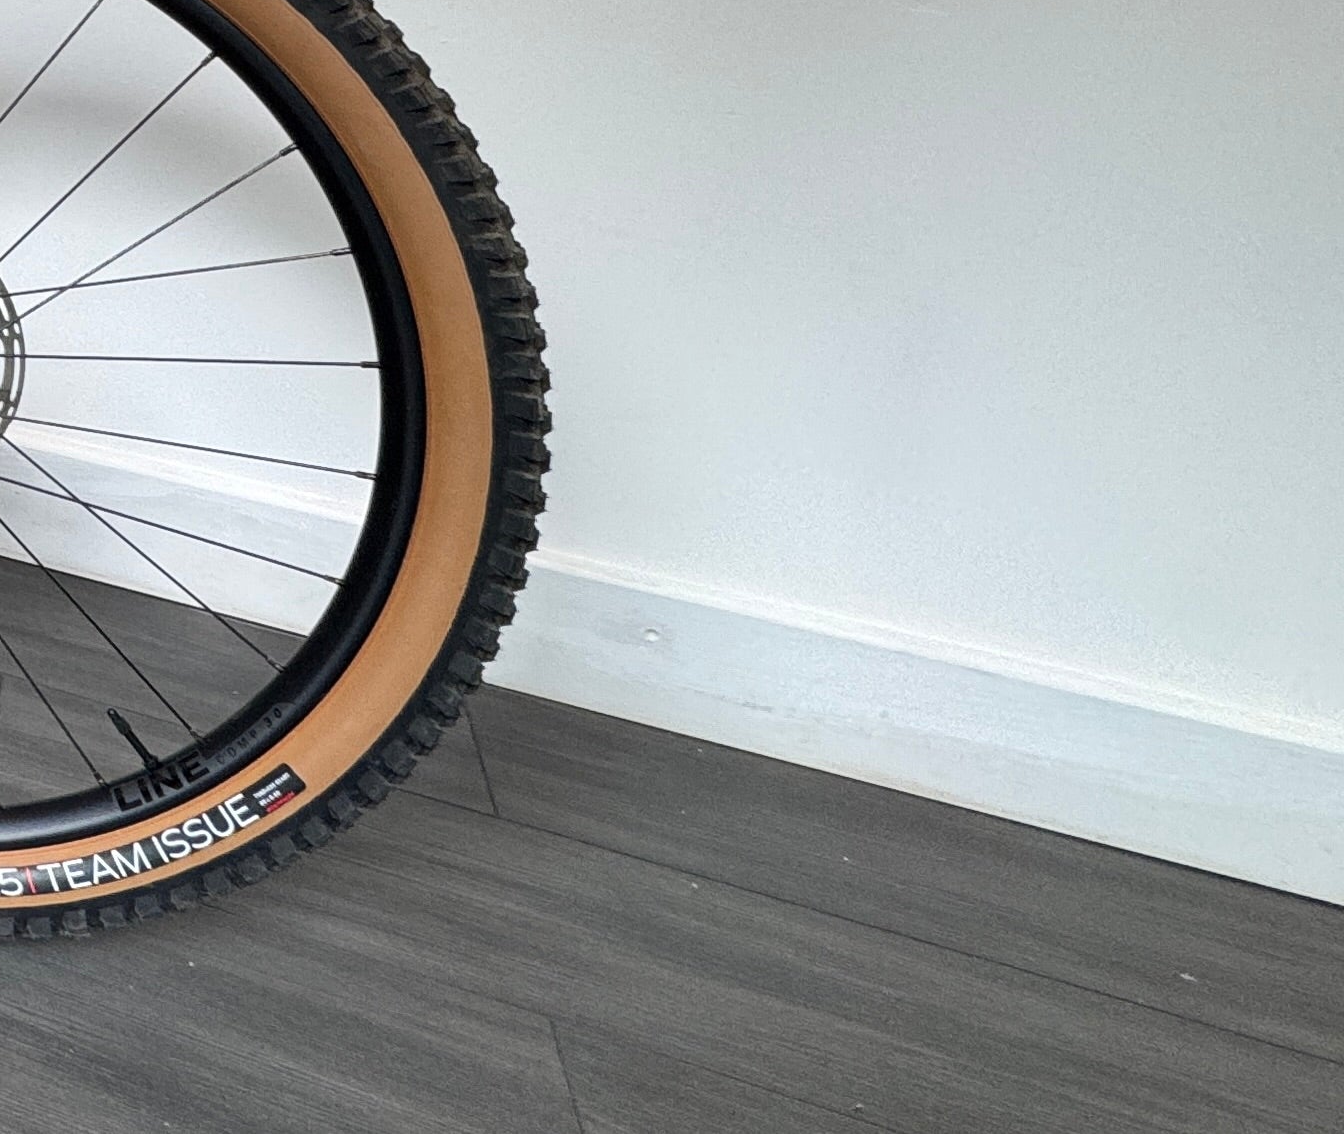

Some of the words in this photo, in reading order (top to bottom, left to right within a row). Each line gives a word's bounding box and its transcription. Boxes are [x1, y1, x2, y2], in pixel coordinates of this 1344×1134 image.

[113, 749, 210, 812] LINE
[36, 841, 153, 893] TEAM
[151, 793, 260, 864] ISSUE
